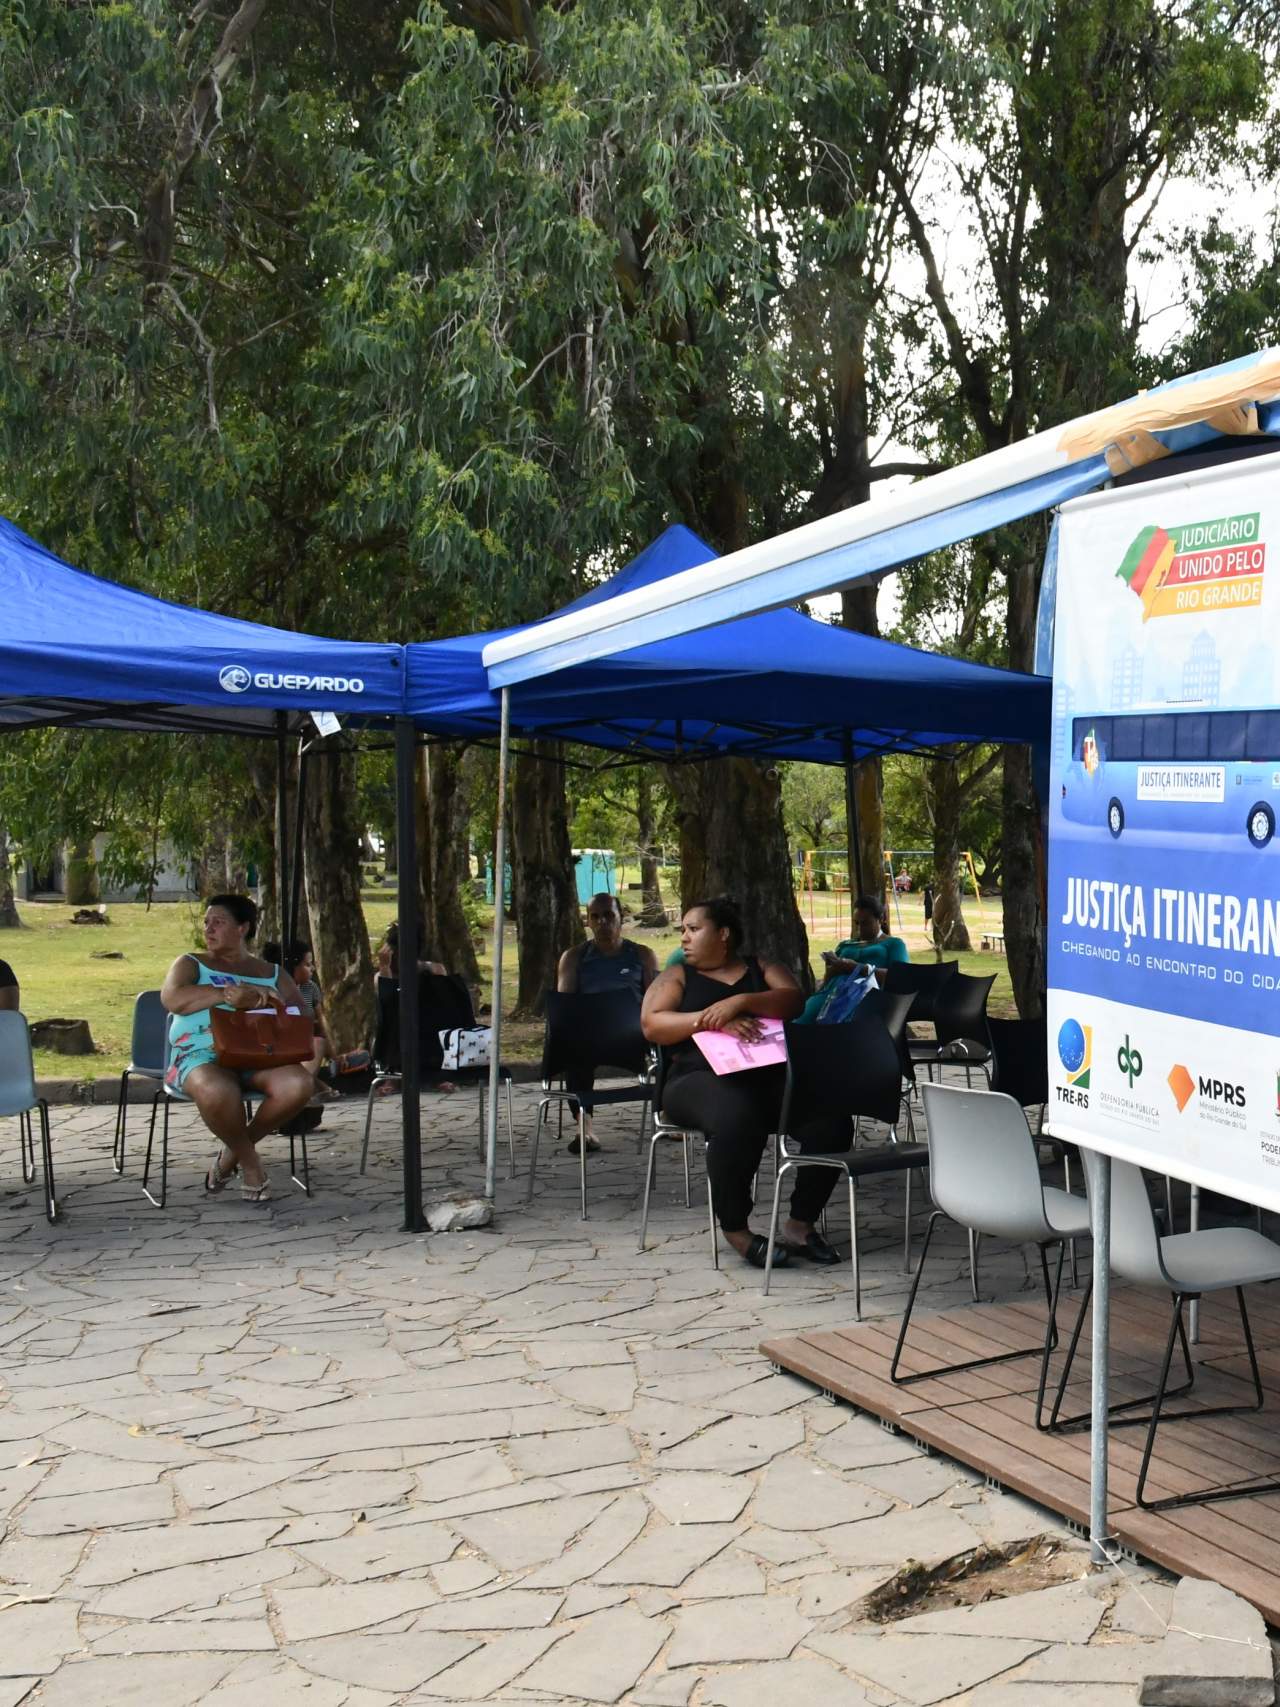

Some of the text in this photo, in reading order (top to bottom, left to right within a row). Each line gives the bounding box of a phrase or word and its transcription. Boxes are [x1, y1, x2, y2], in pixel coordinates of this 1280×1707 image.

[1179, 517, 1255, 553] JUDICIÁRIO
[1179, 548, 1263, 579] UNIDO PELO
[1176, 581, 1262, 609] RIO GRANDE
[254, 673, 365, 693] GUEPARDO
[1140, 771, 1171, 792] JUSTIÇA
[1173, 771, 1221, 788] ITINERANTE
[1061, 877, 1147, 949] JUSTIÇA
[1061, 940, 1121, 962] CHEGANDO
[1126, 953, 1141, 967] AO
[1146, 956, 1217, 980] ENCONTRO
[1223, 969, 1244, 985] DO
[1055, 1086, 1089, 1110] TRE-RS
[1198, 1075, 1246, 1108] MPRS
